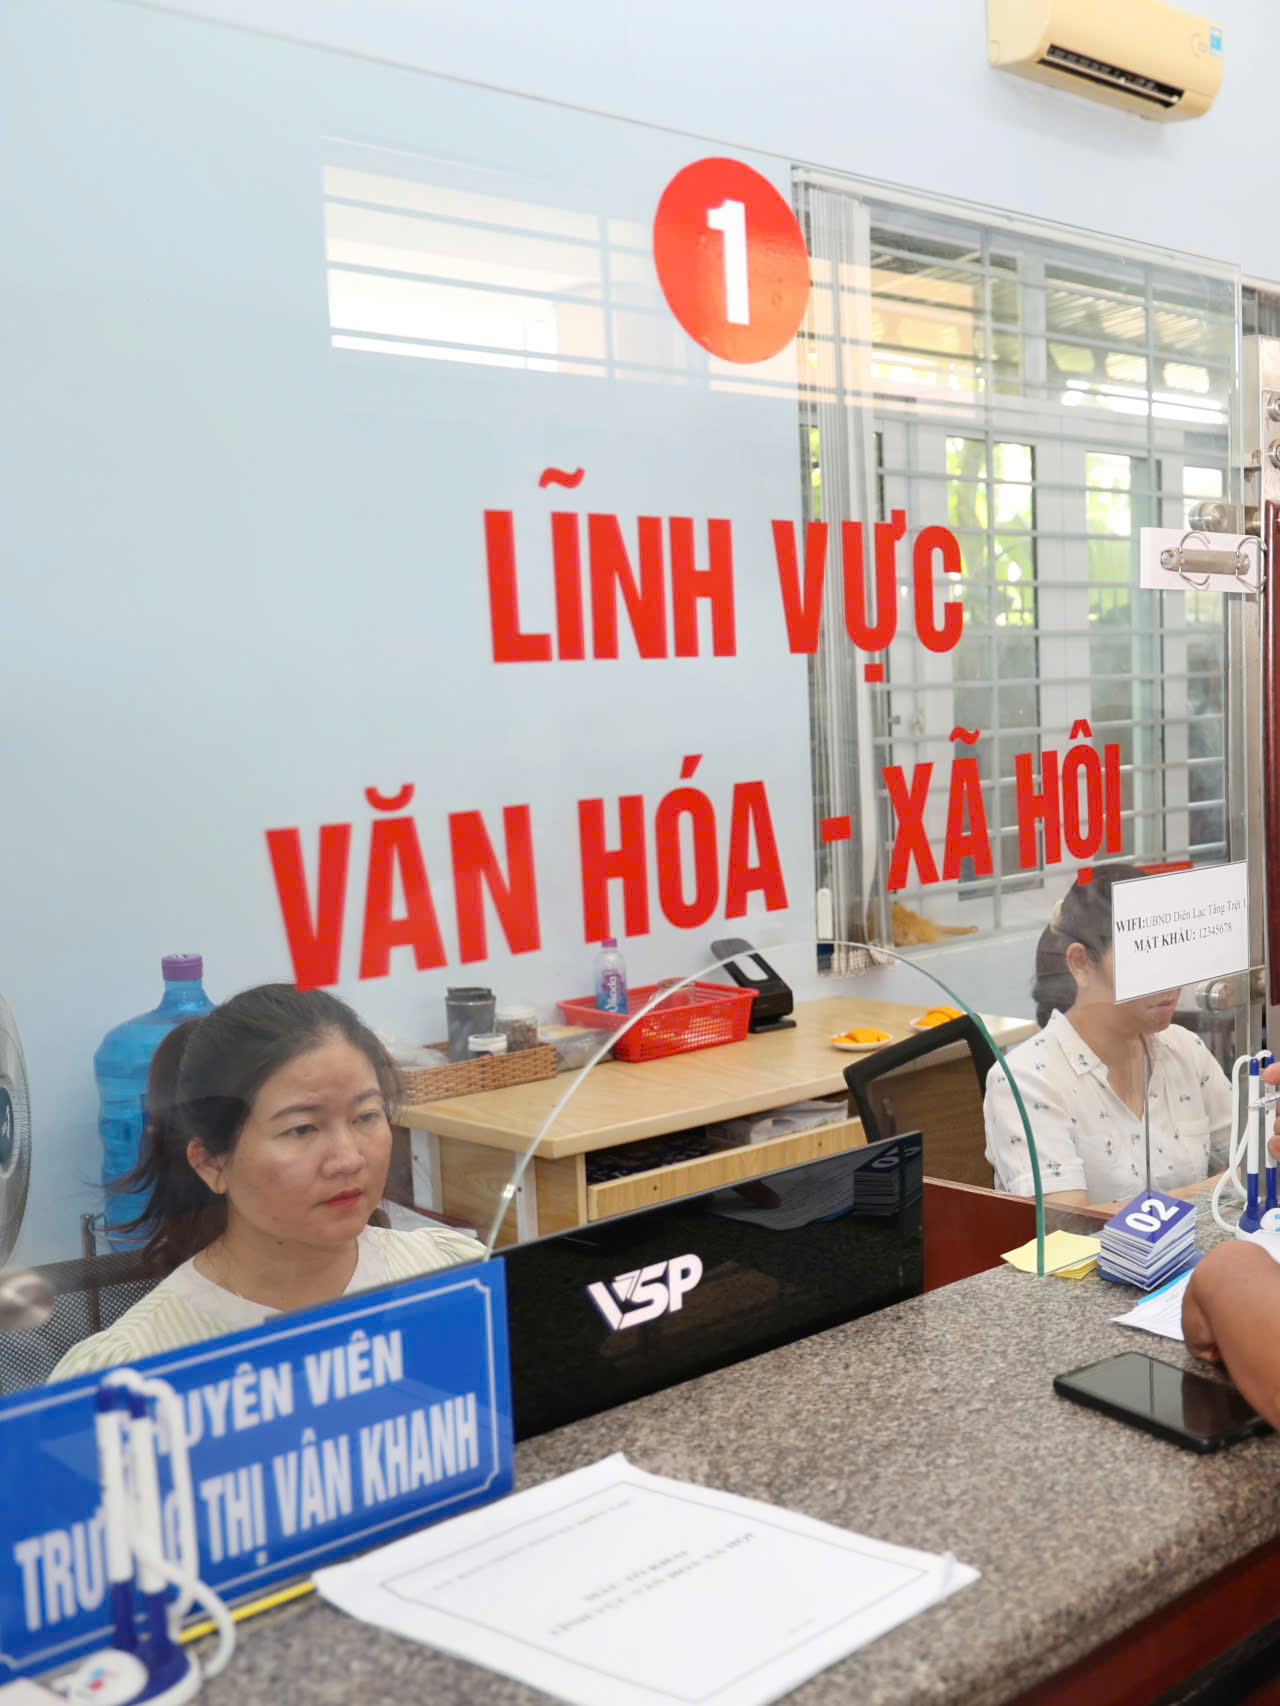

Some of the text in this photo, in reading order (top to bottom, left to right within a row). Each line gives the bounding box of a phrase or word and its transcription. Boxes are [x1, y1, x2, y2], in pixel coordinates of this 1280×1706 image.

[707, 200, 749, 325] 1
[484, 467, 963, 683] LĨNH VỰC
[265, 784, 541, 993] VĂN
[578, 754, 789, 944] HÓA
[882, 728, 993, 890] XÃ
[1015, 719, 1122, 886] HỘI
[1199, 922, 1232, 938] 12345678
[1124, 1198, 1180, 1233] 02
[587, 1254, 703, 1331] VSP
[150, 1330, 403, 1456] UYÊN VIÊN
[200, 1463, 267, 1567] THỊ
[272, 1427, 351, 1536] VÂN
[359, 1393, 478, 1506] KHANH
